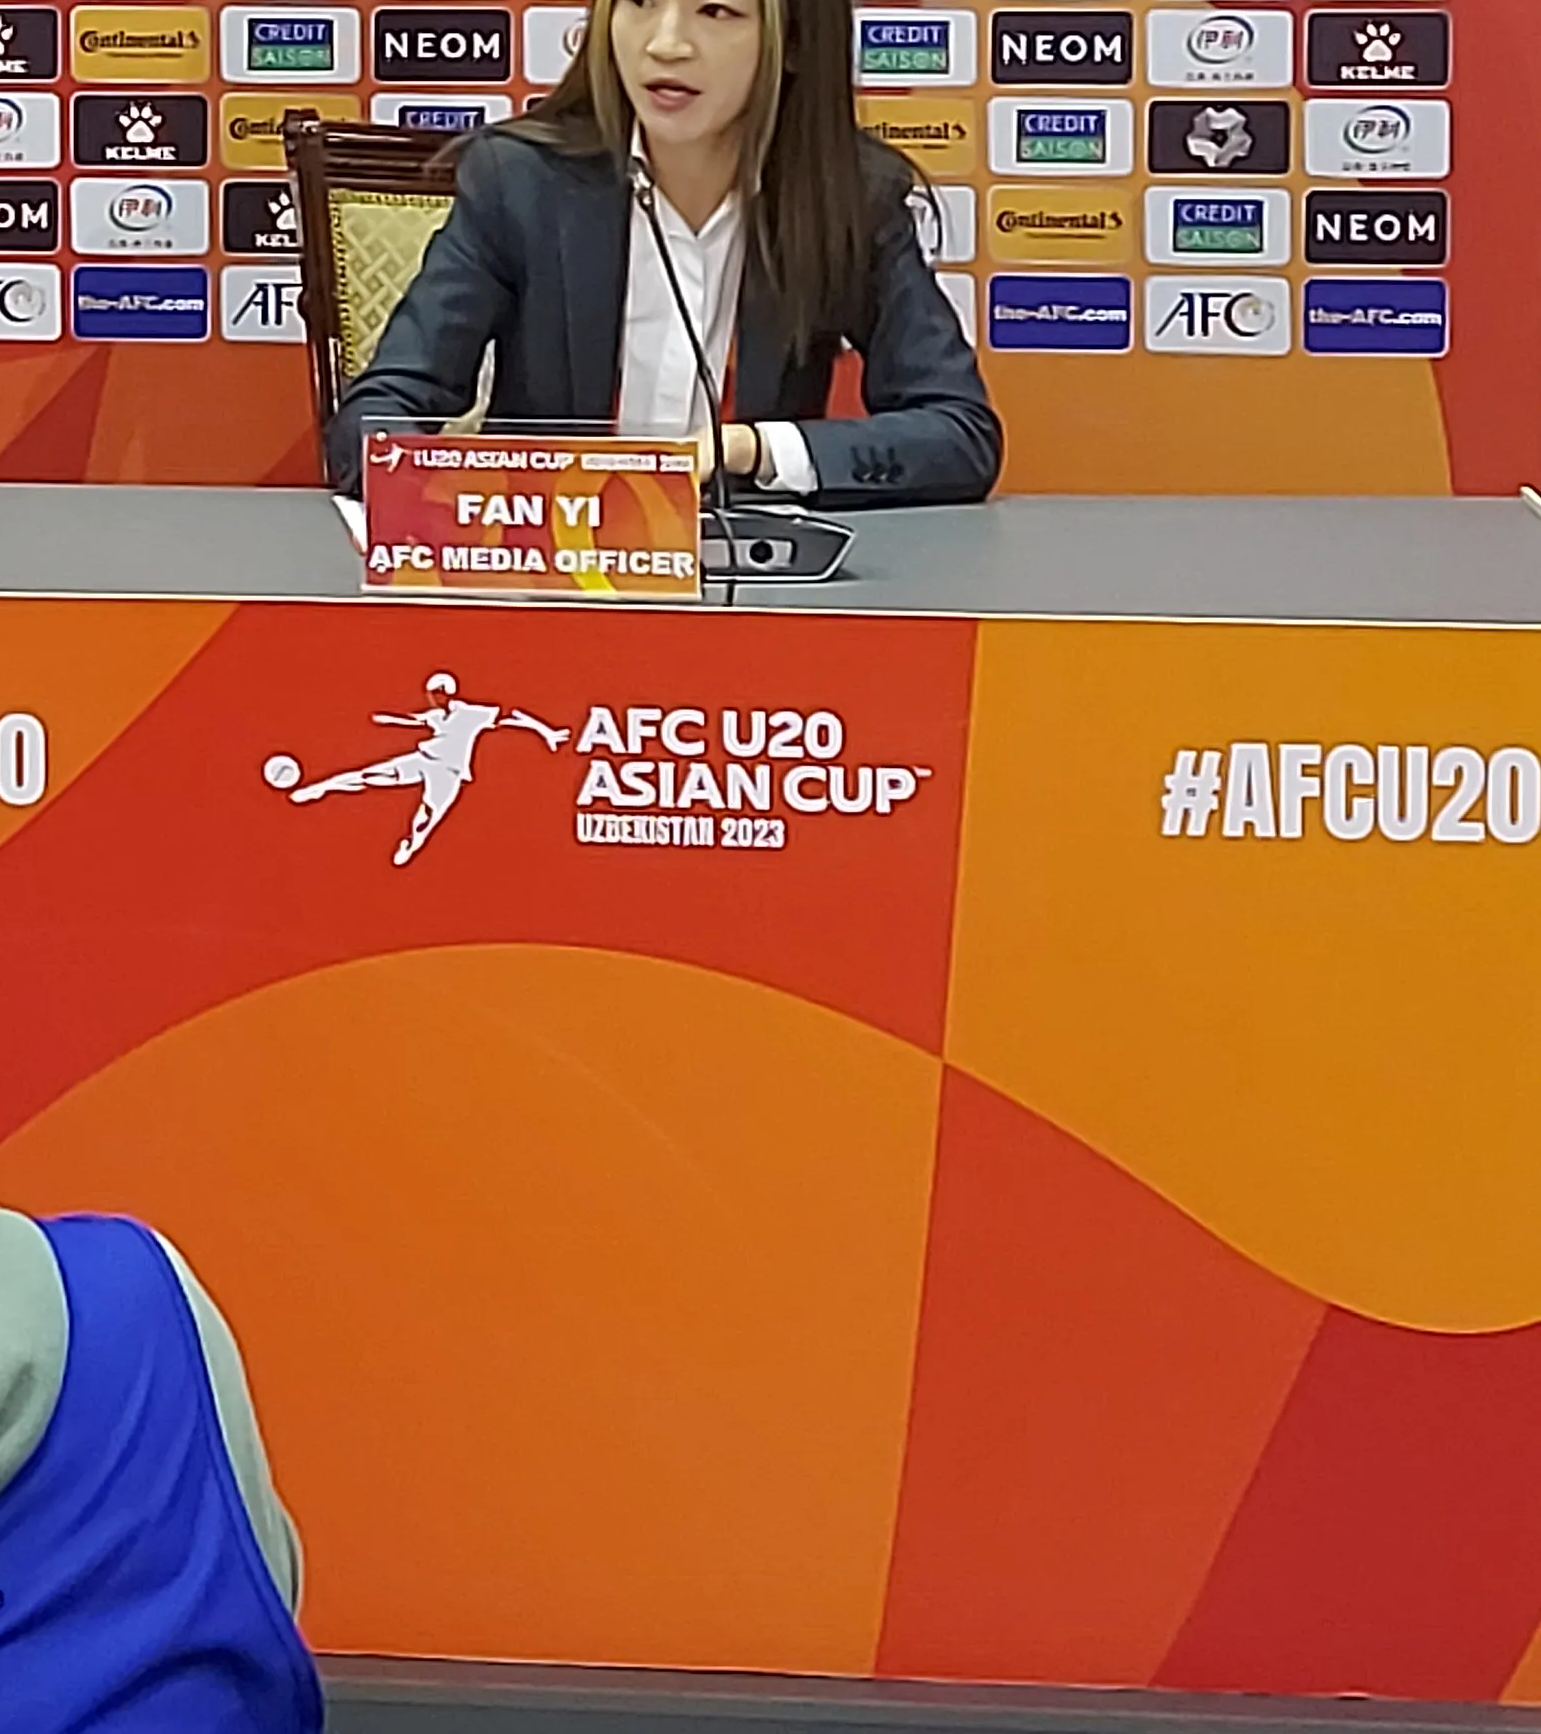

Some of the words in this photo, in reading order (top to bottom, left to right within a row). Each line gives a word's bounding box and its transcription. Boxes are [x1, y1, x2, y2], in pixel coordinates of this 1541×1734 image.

[386, 33, 499, 58] NEOM
[867, 27, 942, 47] CREDIT
[1003, 34, 1121, 64] NEOM
[1180, 204, 1256, 224] CREDIT
[1317, 214, 1434, 241] NEOM
[1157, 293, 1256, 336] AFC
[457, 494, 543, 525] FAN
[555, 496, 600, 527] YI
[369, 546, 434, 570] AFC
[442, 547, 546, 572] MEDIA
[554, 549, 694, 578] OFFICER
[576, 706, 705, 756] AFC
[722, 710, 844, 759] U20
[577, 760, 771, 810] ASIAN
[782, 765, 917, 813] CUP
[1162, 743, 1541, 843] #AFCU20
[721, 818, 784, 848] 2023
